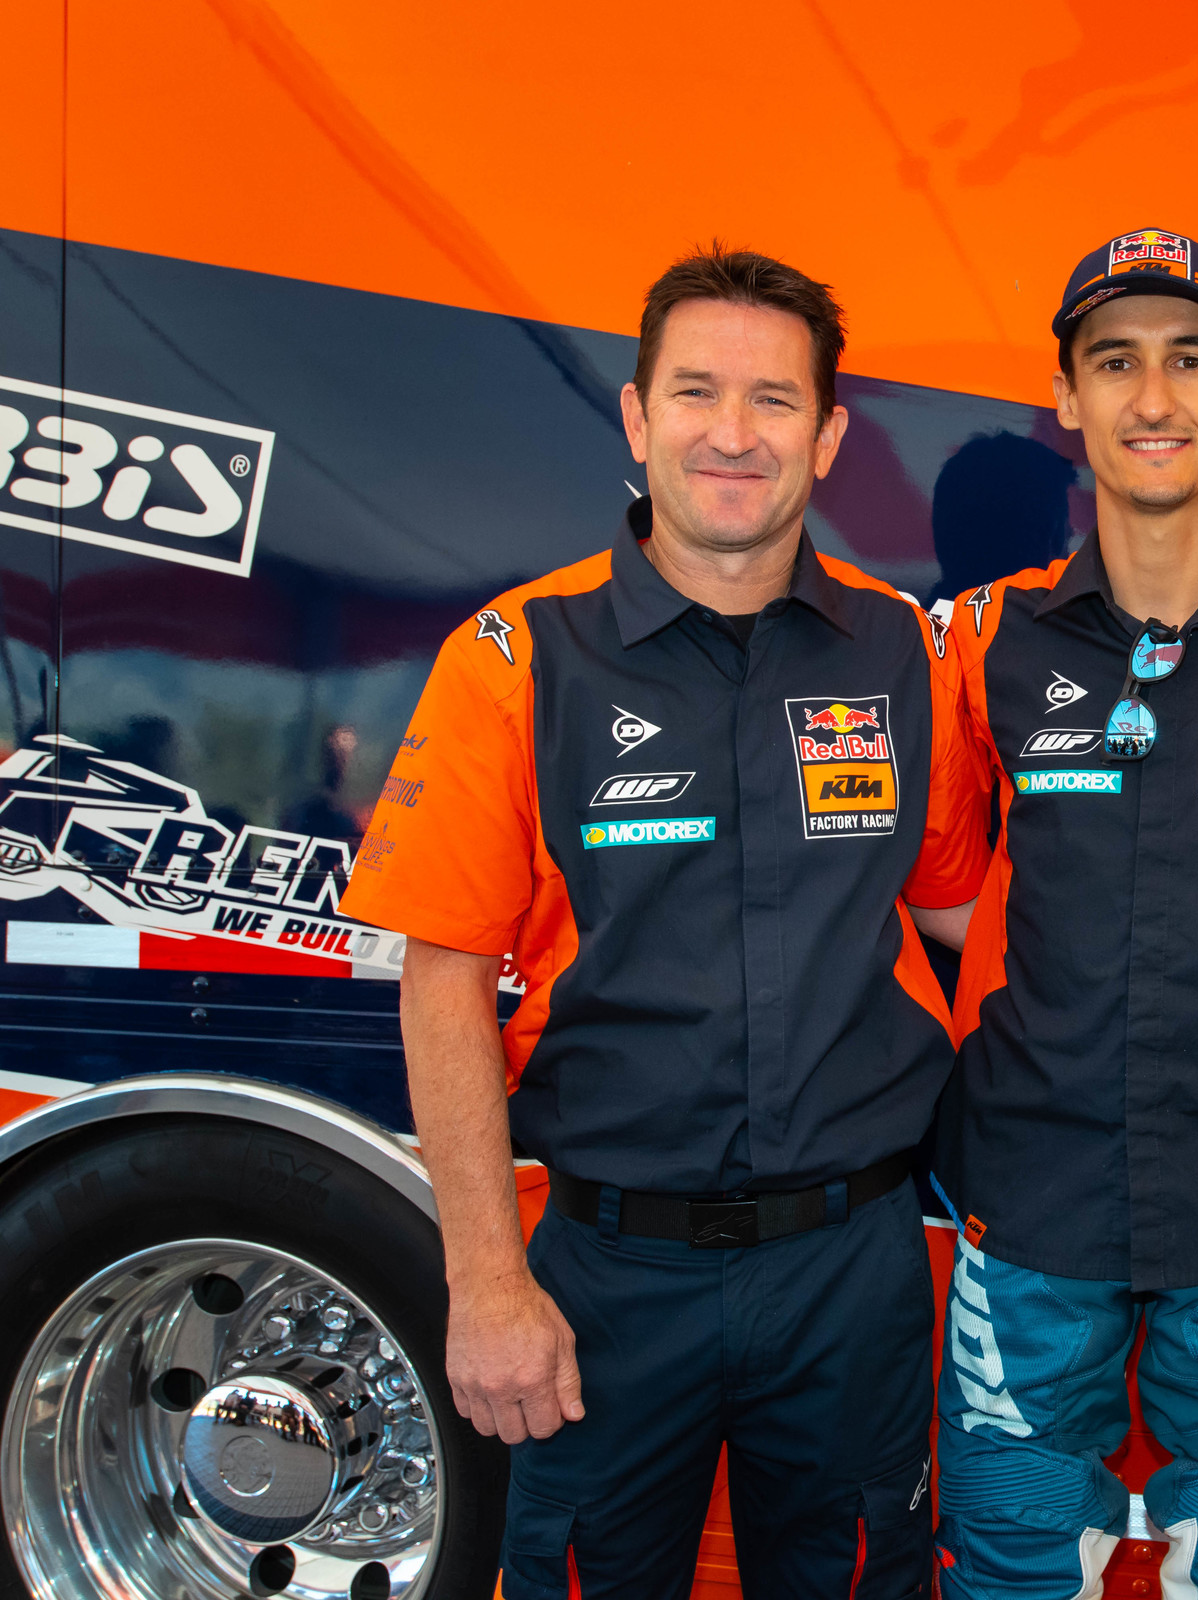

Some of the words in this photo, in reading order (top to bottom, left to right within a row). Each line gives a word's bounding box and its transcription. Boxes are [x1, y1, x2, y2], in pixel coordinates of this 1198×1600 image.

[1112, 245, 1150, 264] Red
[1150, 245, 1187, 263] Bull
[1129, 262, 1171, 273] KTM
[798, 735, 849, 761] Red
[846, 733, 889, 759] Bull
[1029, 733, 1094, 751] WP
[603, 778, 679, 800] WP
[819, 775, 882, 800] KTM
[809, 815, 859, 831] FACTORY
[862, 814, 895, 828] RACING
[212, 906, 274, 940] WE
[277, 919, 380, 959] BUILD
[967, 1221, 983, 1236] KTM
